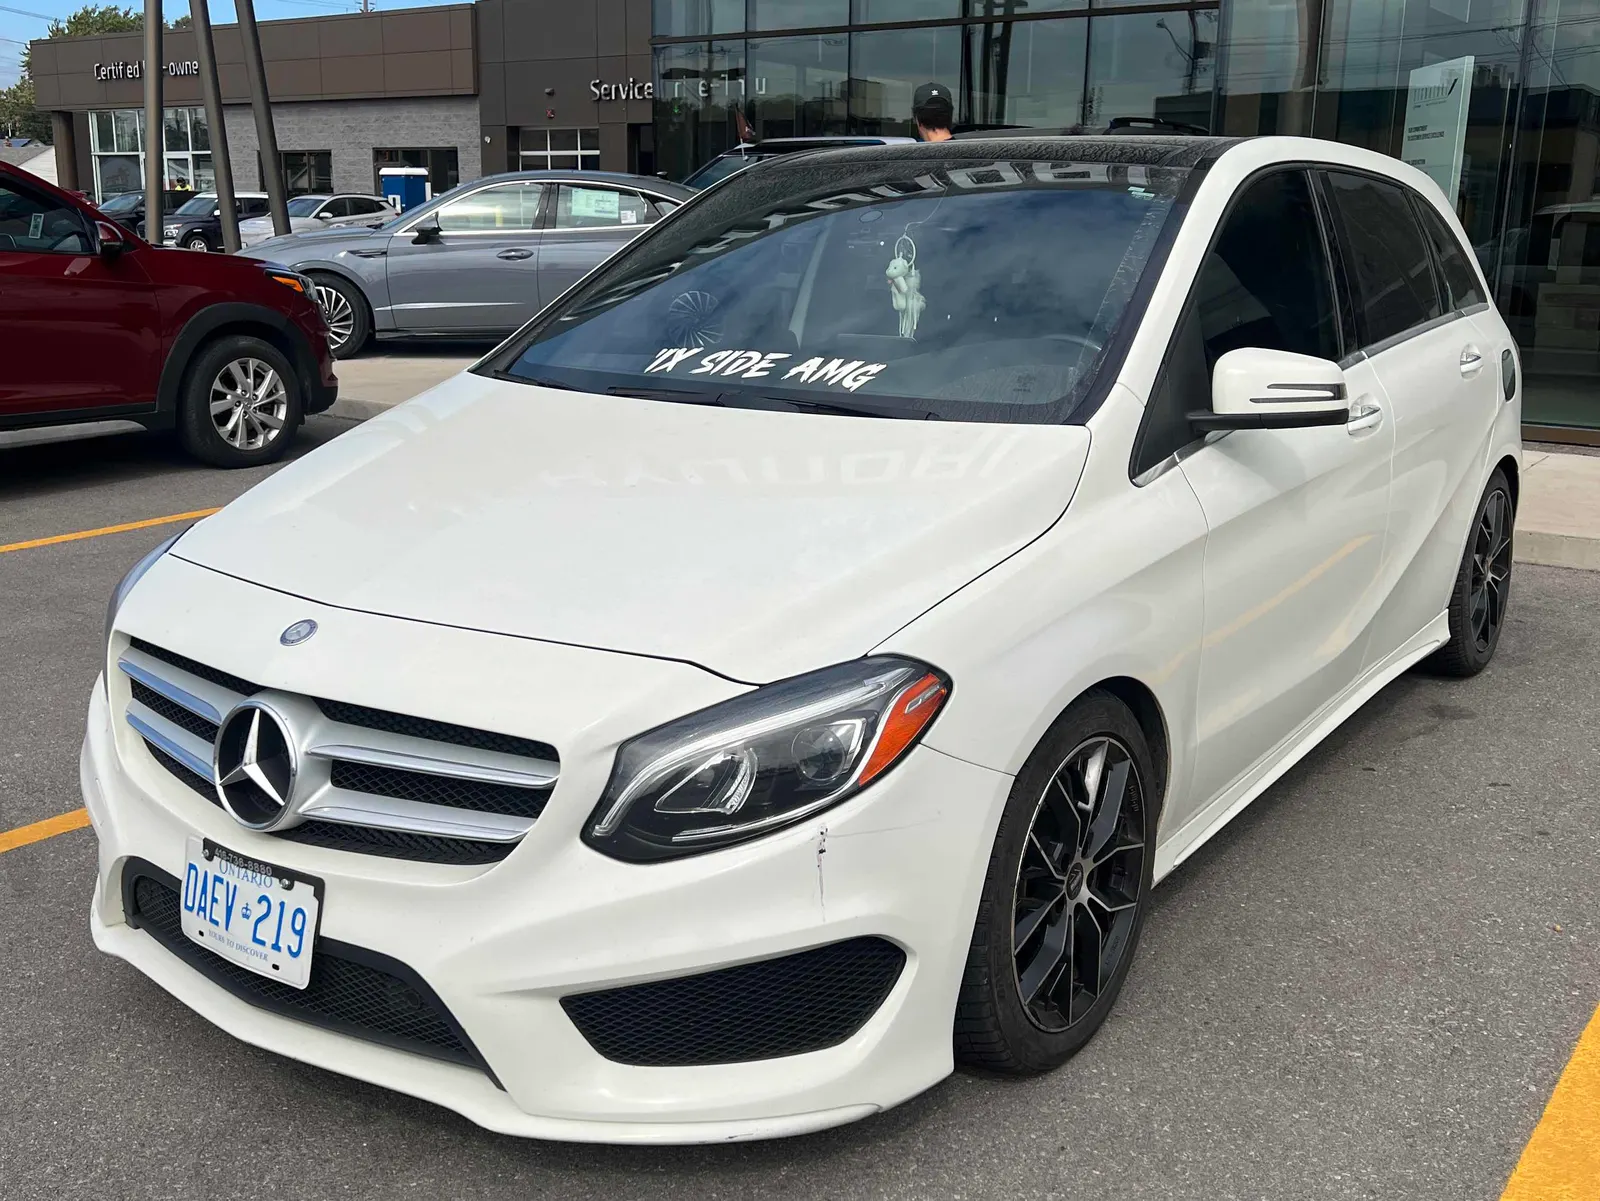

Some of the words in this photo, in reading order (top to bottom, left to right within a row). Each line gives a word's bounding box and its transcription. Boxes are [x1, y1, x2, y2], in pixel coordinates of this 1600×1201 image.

[590, 77, 654, 101] Service
[688, 349, 793, 379] SIDE
[780, 356, 888, 393] AMG
[219, 859, 273, 888] ONTARIO
[184, 862, 238, 932] DAEV
[251, 893, 307, 959] 219
[226, 938, 235, 948] TO
[235, 942, 269, 962] DISCOVER
